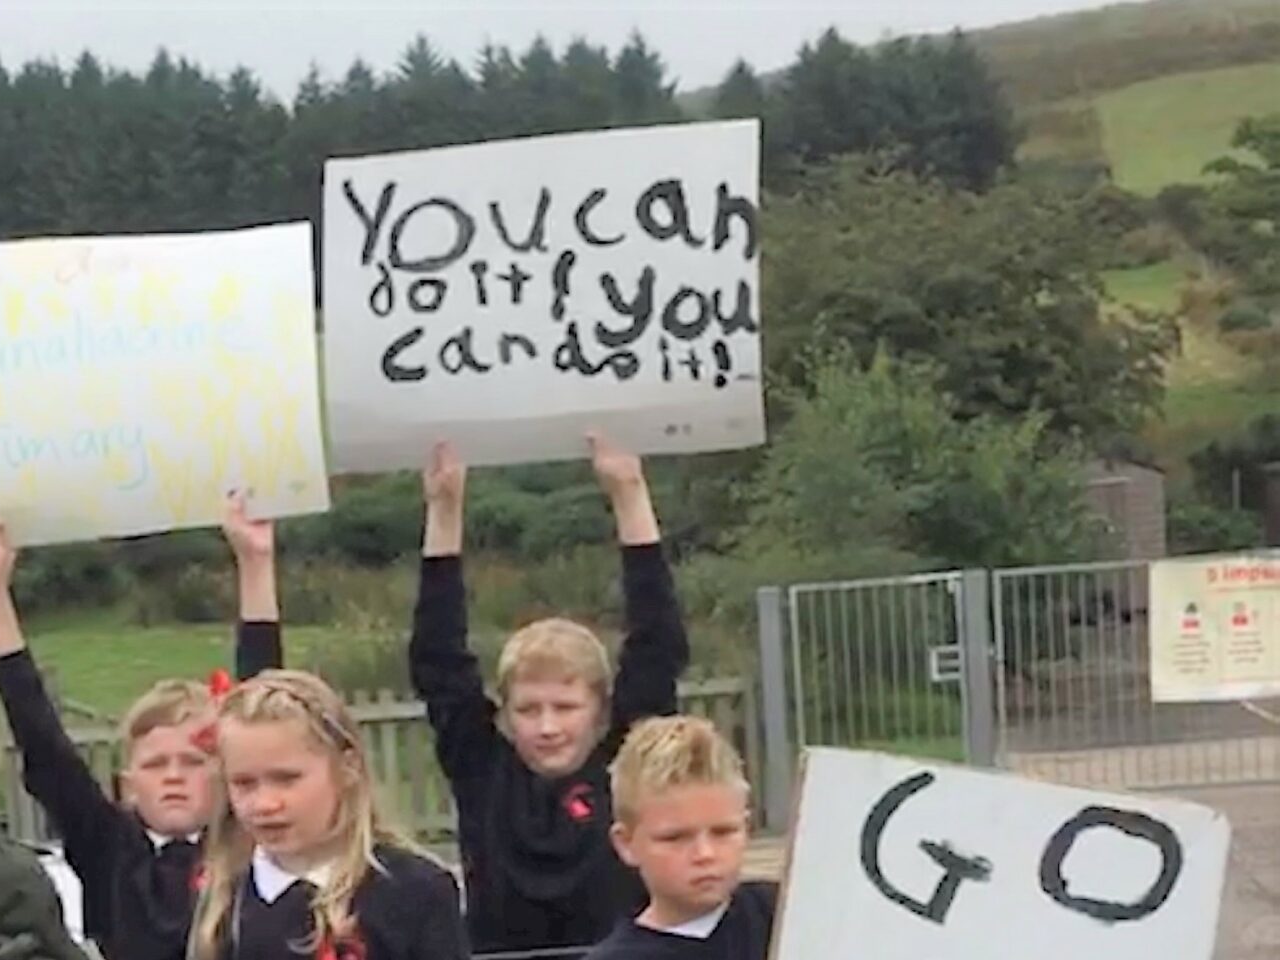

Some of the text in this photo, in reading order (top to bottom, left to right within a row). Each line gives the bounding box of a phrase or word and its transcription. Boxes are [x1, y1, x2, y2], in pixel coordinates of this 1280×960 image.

[574, 178, 757, 260] can
[369, 261, 448, 317] do
[595, 266, 757, 347] you
[381, 322, 732, 388] can do it!
[859, 771, 1184, 925] GO
